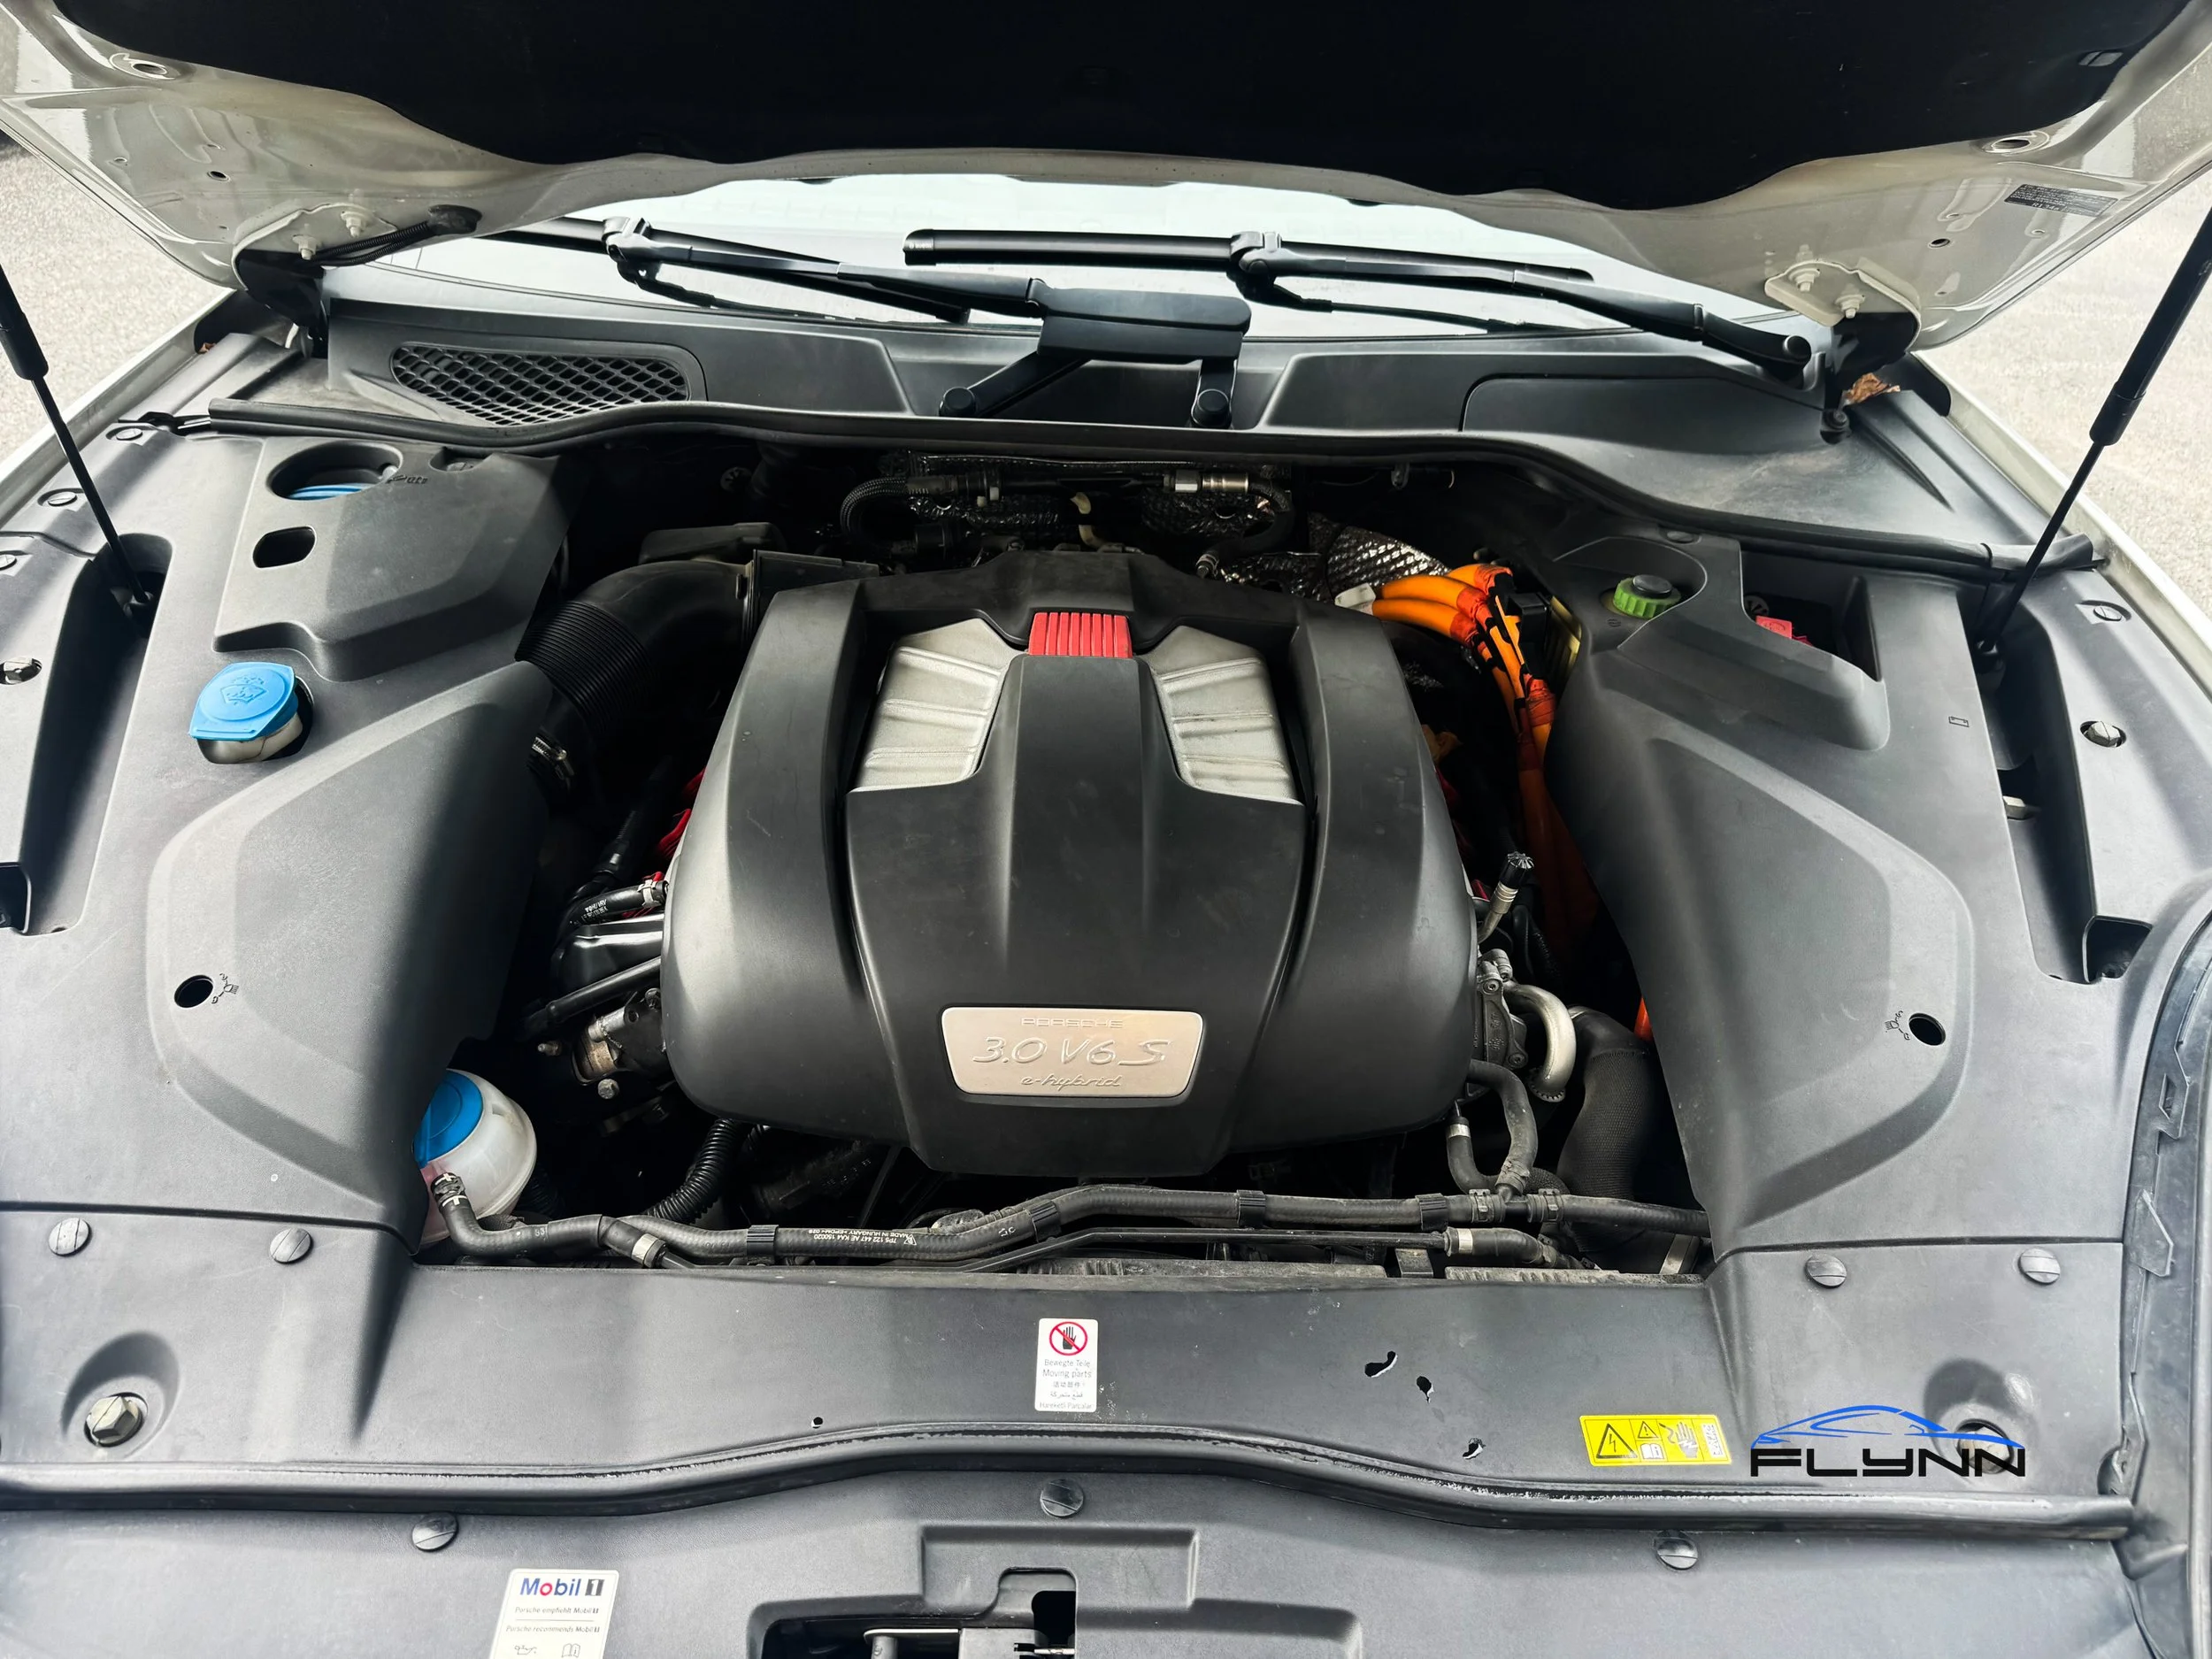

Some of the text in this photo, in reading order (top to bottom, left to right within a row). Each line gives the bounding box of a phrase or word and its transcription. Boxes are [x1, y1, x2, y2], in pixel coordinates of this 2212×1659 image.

[1021, 1018, 1125, 1029] PORSCHE
[972, 1036, 1172, 1066] 3.0 V6 S
[1020, 1073, 1123, 1092] e-hybrid
[1042, 1369, 1070, 1379] Moving
[520, 1578, 605, 1596] Mobil 1
